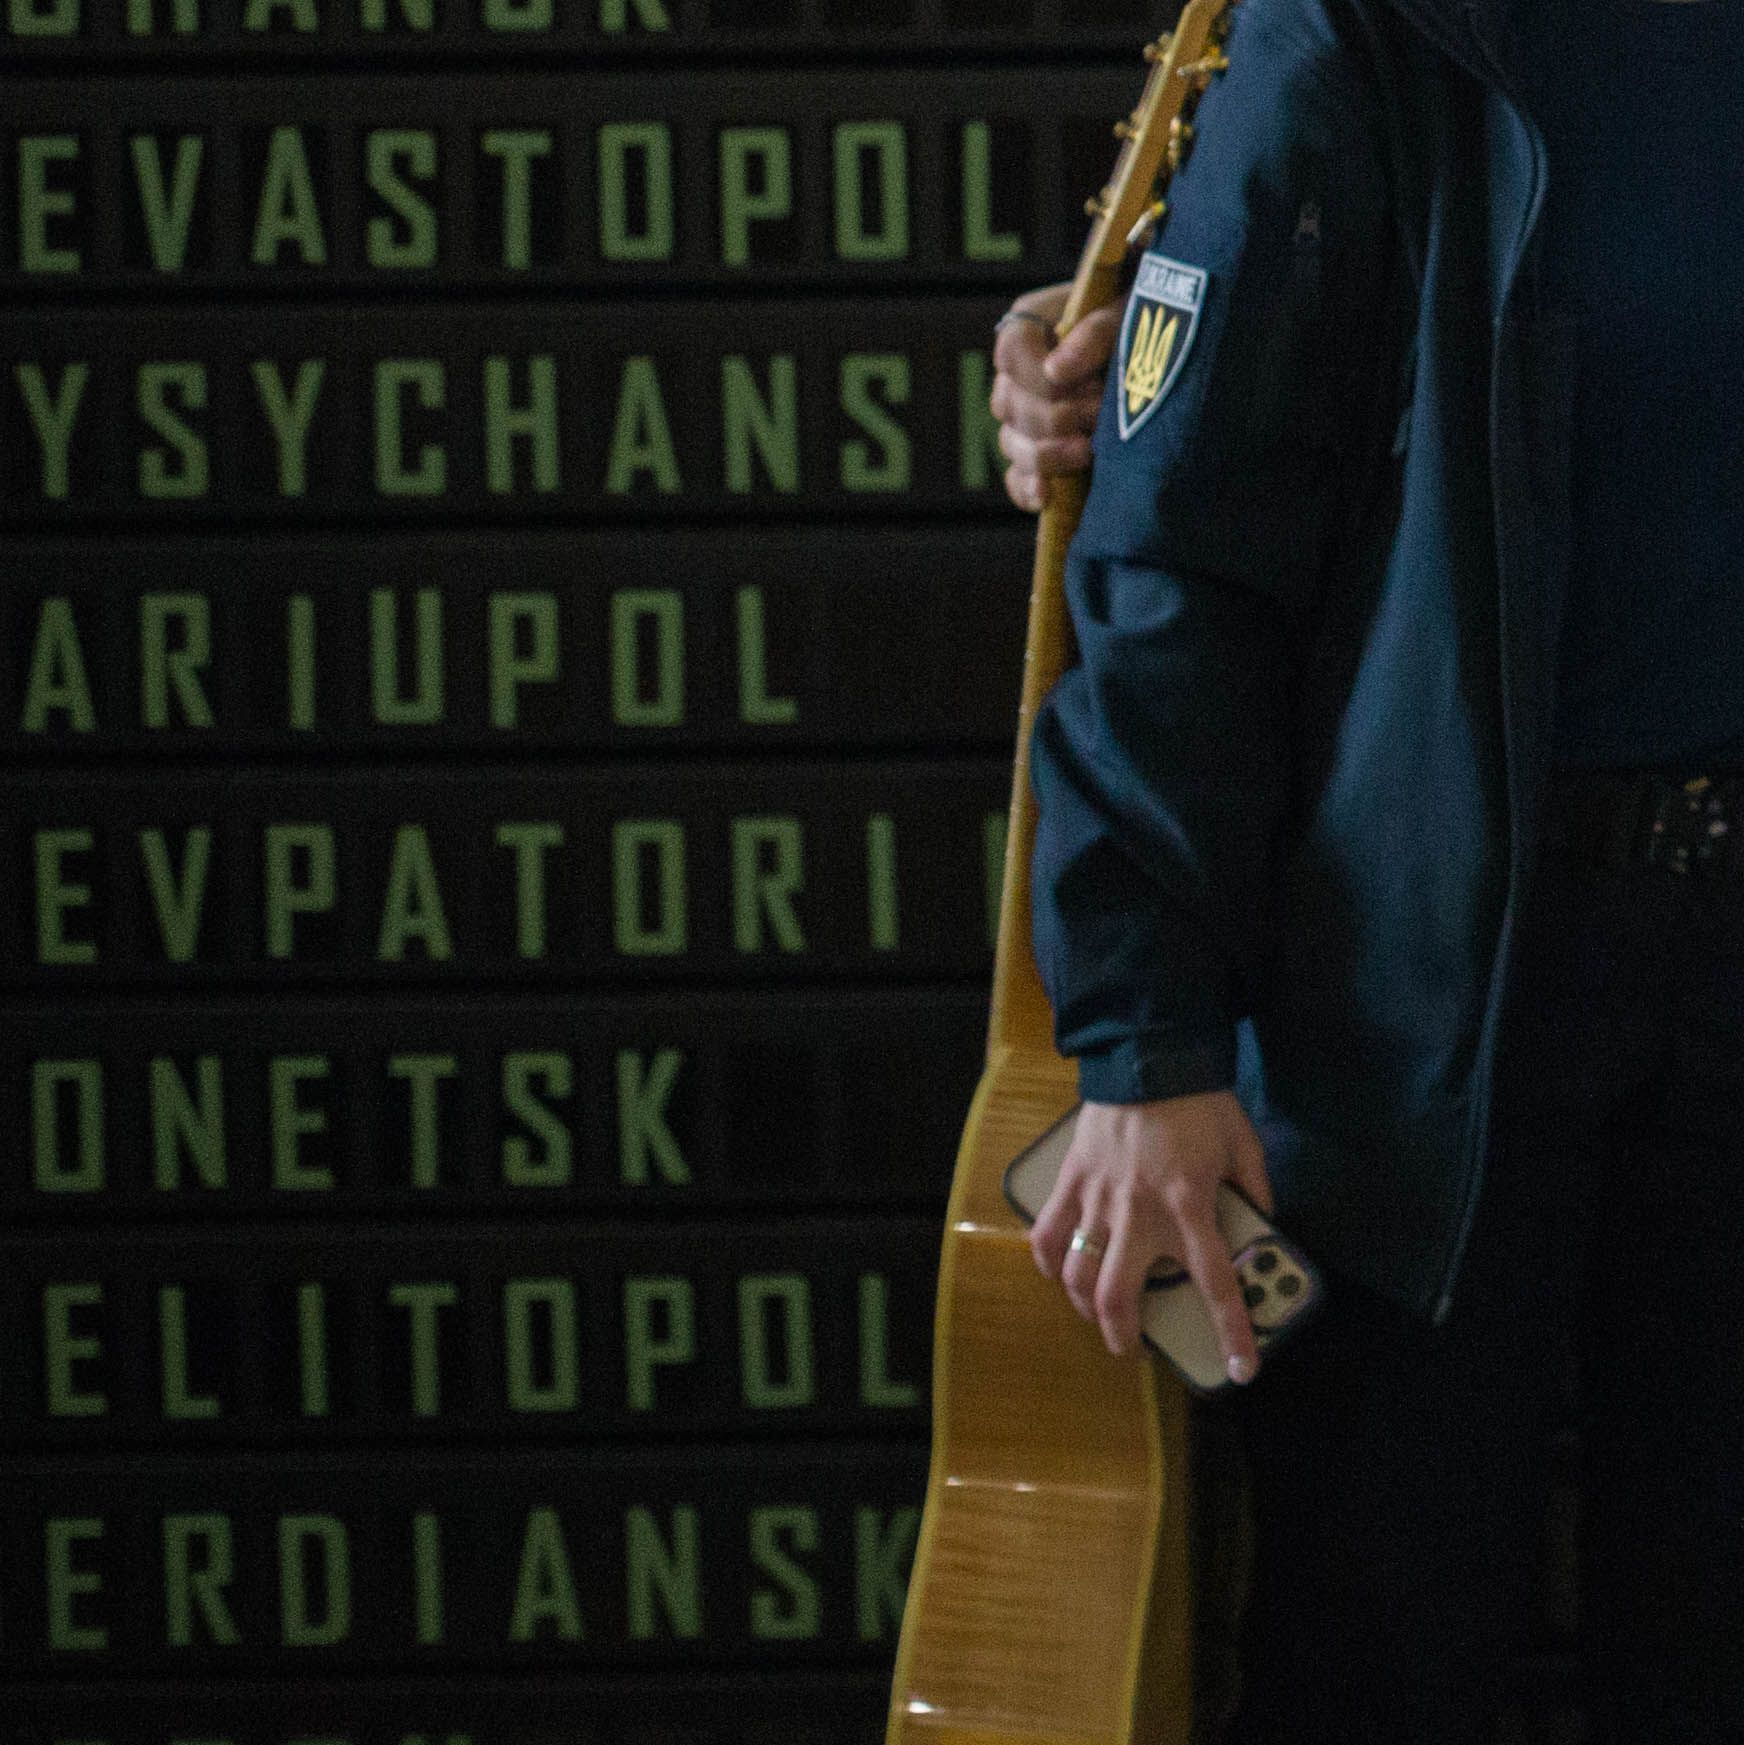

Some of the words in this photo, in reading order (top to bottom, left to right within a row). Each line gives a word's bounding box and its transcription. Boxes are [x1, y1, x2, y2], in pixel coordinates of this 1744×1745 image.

[17, 122, 1022, 273] EVASTOPOL
[20, 585, 798, 734] ARIUPOL
[32, 1049, 692, 1193] ONETSK
[43, 1273, 922, 1420] ELITOPOL
[45, 1506, 922, 1652] ERDIANSK
